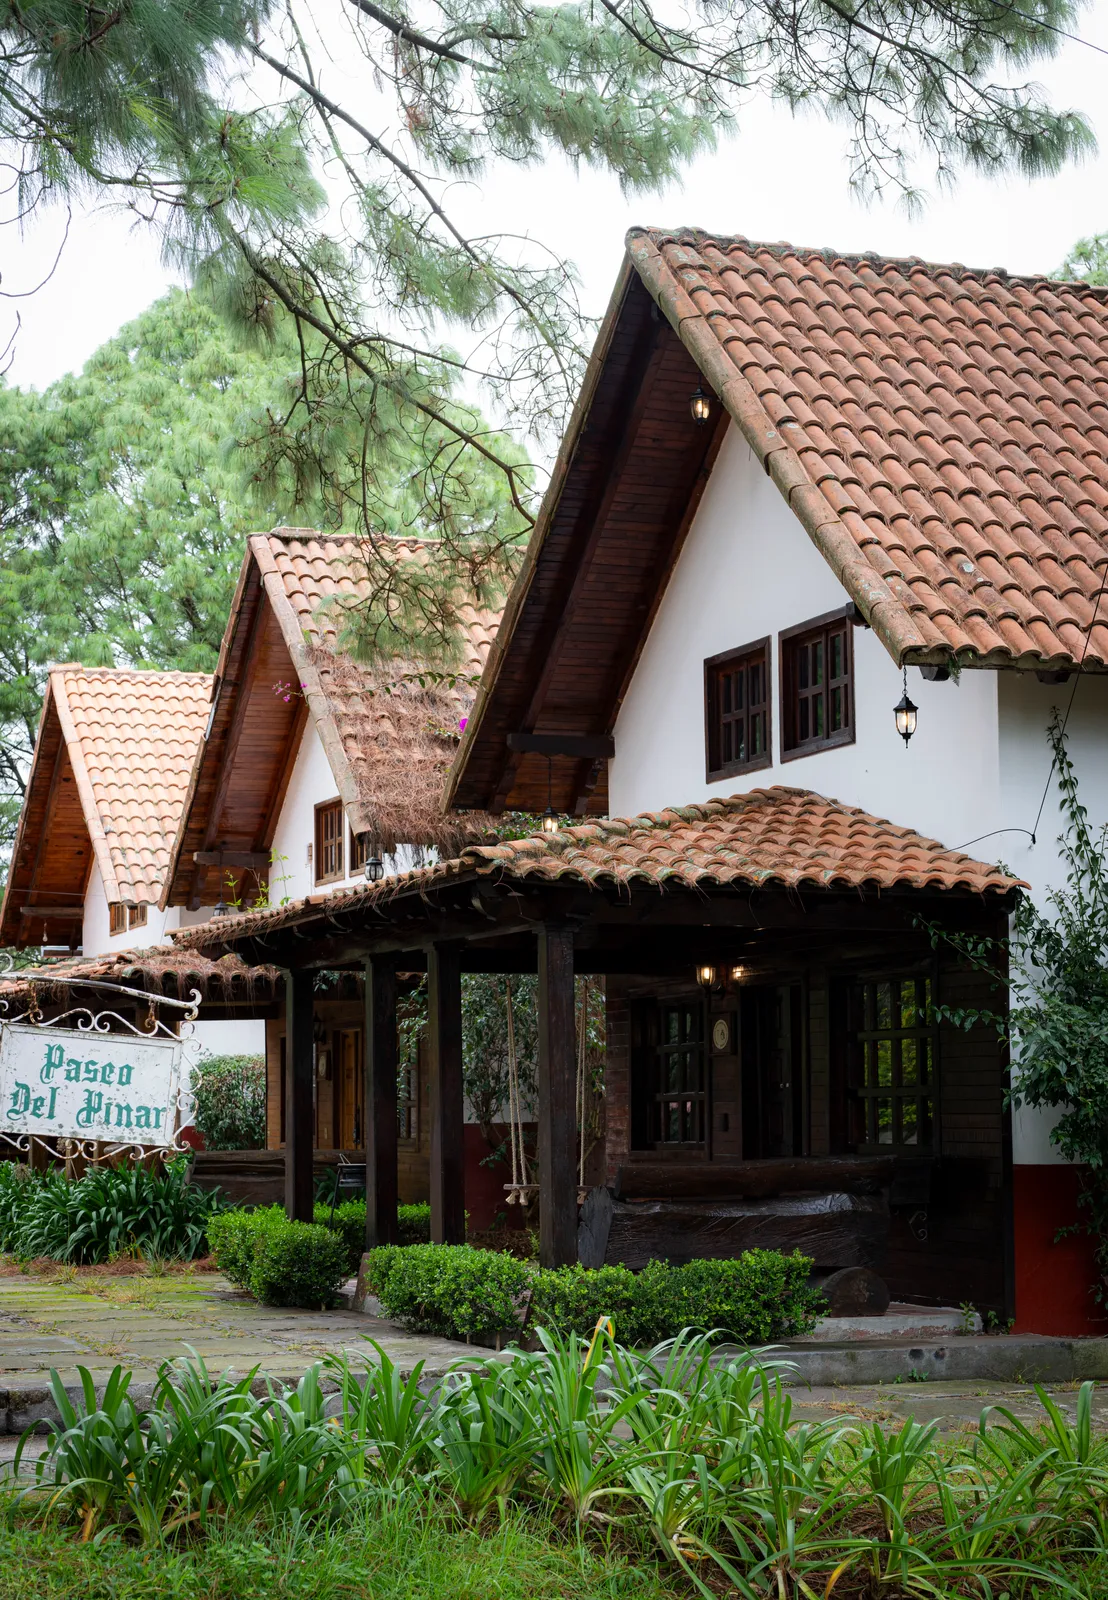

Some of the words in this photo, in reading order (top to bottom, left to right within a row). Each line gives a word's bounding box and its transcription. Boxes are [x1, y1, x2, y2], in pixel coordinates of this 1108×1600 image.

[40, 1043, 135, 1085] Paseo
[7, 1081, 61, 1121] Del
[76, 1089, 167, 1129] Pinar
